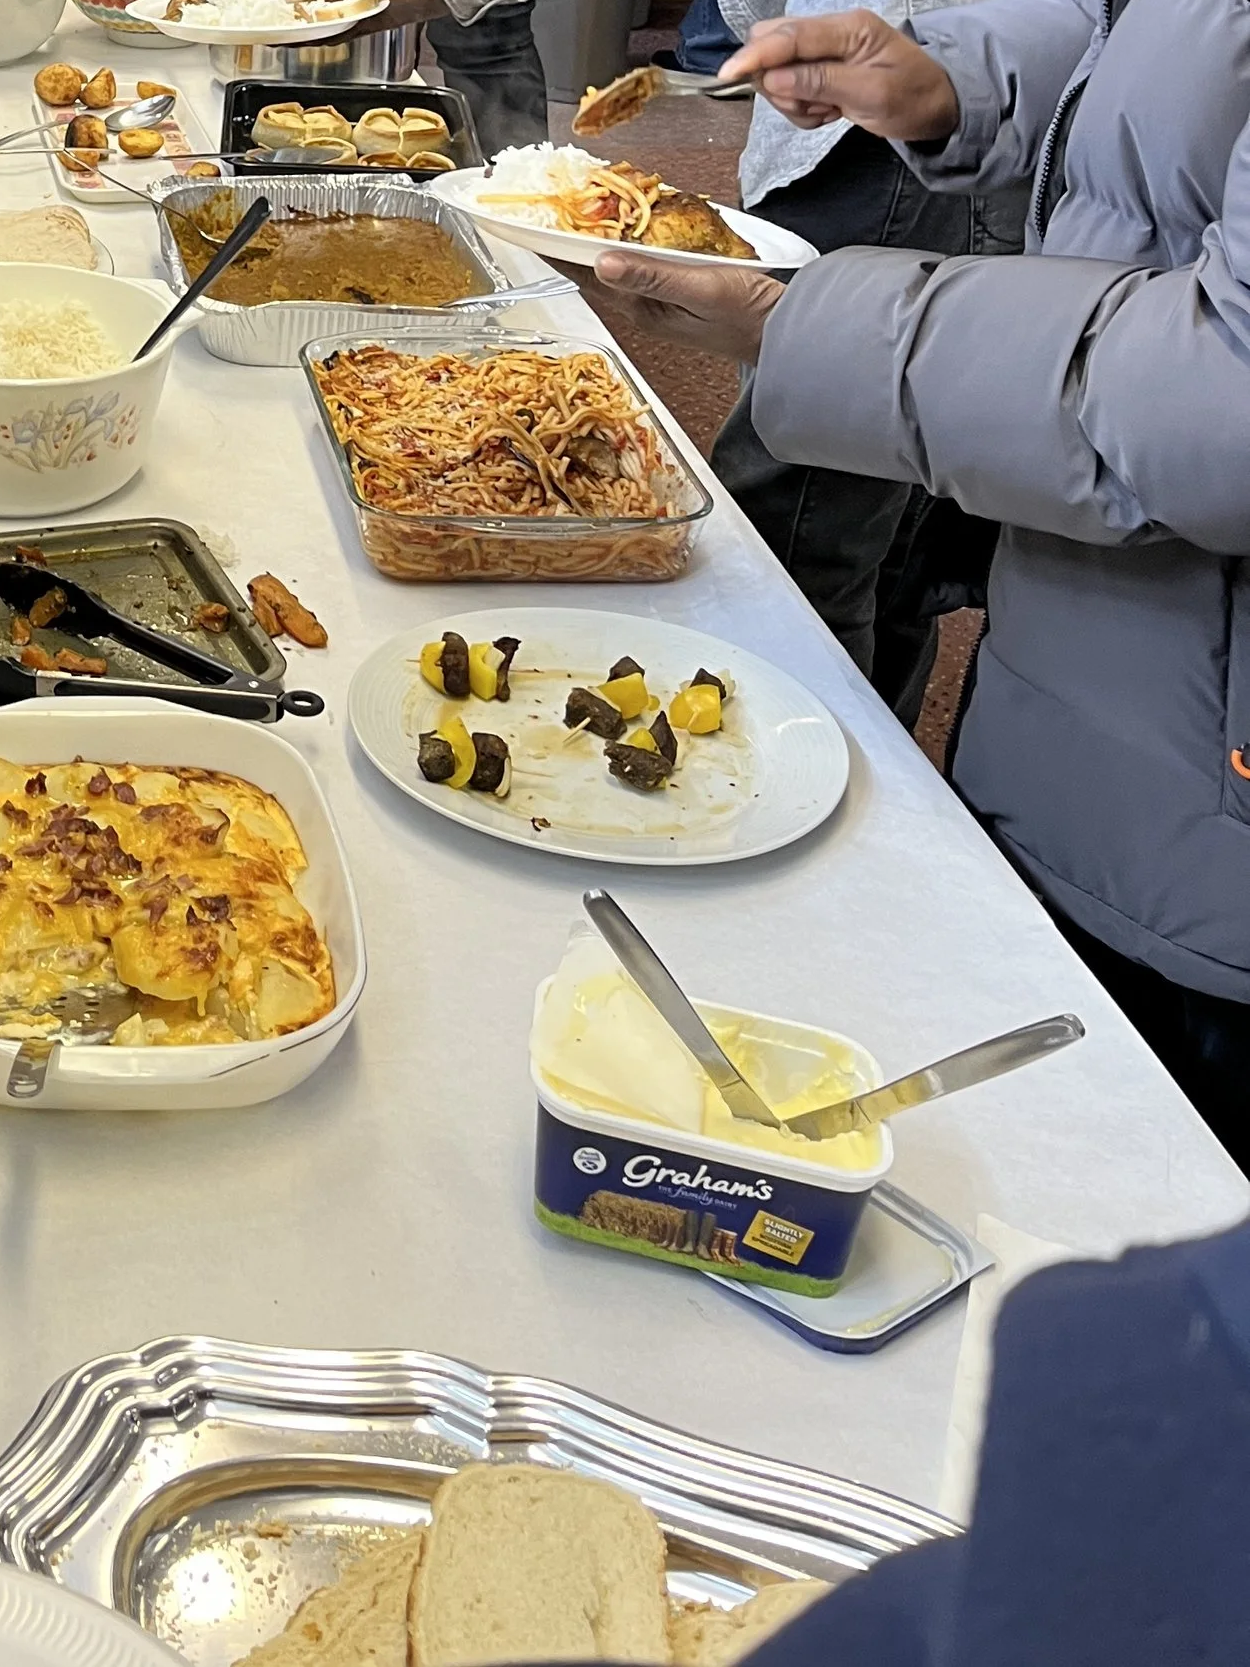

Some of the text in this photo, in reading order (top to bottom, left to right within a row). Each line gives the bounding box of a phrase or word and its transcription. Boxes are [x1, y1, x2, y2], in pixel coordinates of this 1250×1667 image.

[622, 1154, 774, 1201] Graham's
[670, 1186, 714, 1206] family
[763, 1218, 804, 1240] SLIGHTLY
[763, 1226, 799, 1245] SALTED
